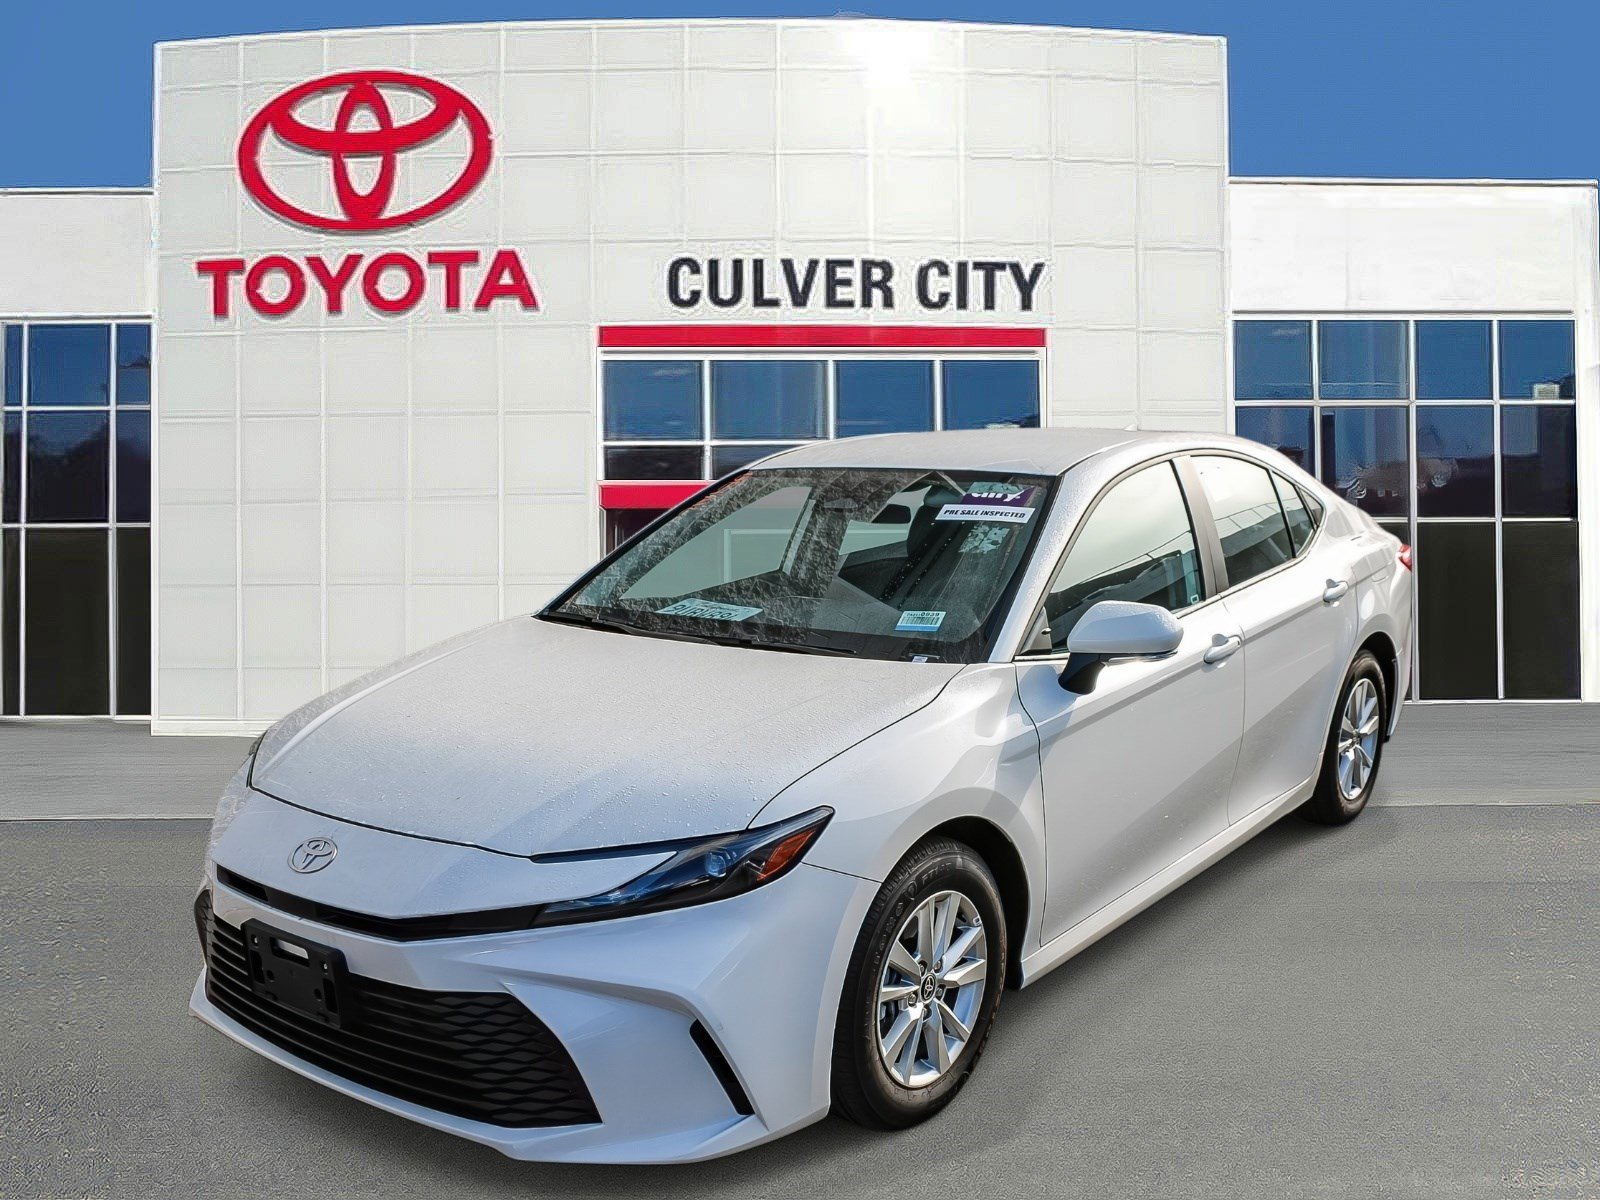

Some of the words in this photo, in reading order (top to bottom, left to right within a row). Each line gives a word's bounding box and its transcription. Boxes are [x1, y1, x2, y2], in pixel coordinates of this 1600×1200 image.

[196, 250, 539, 319] TOYOTA
[667, 257, 895, 309] CULVER
[915, 258, 1046, 312] CITY
[980, 510, 1026, 519] INSPECTED
